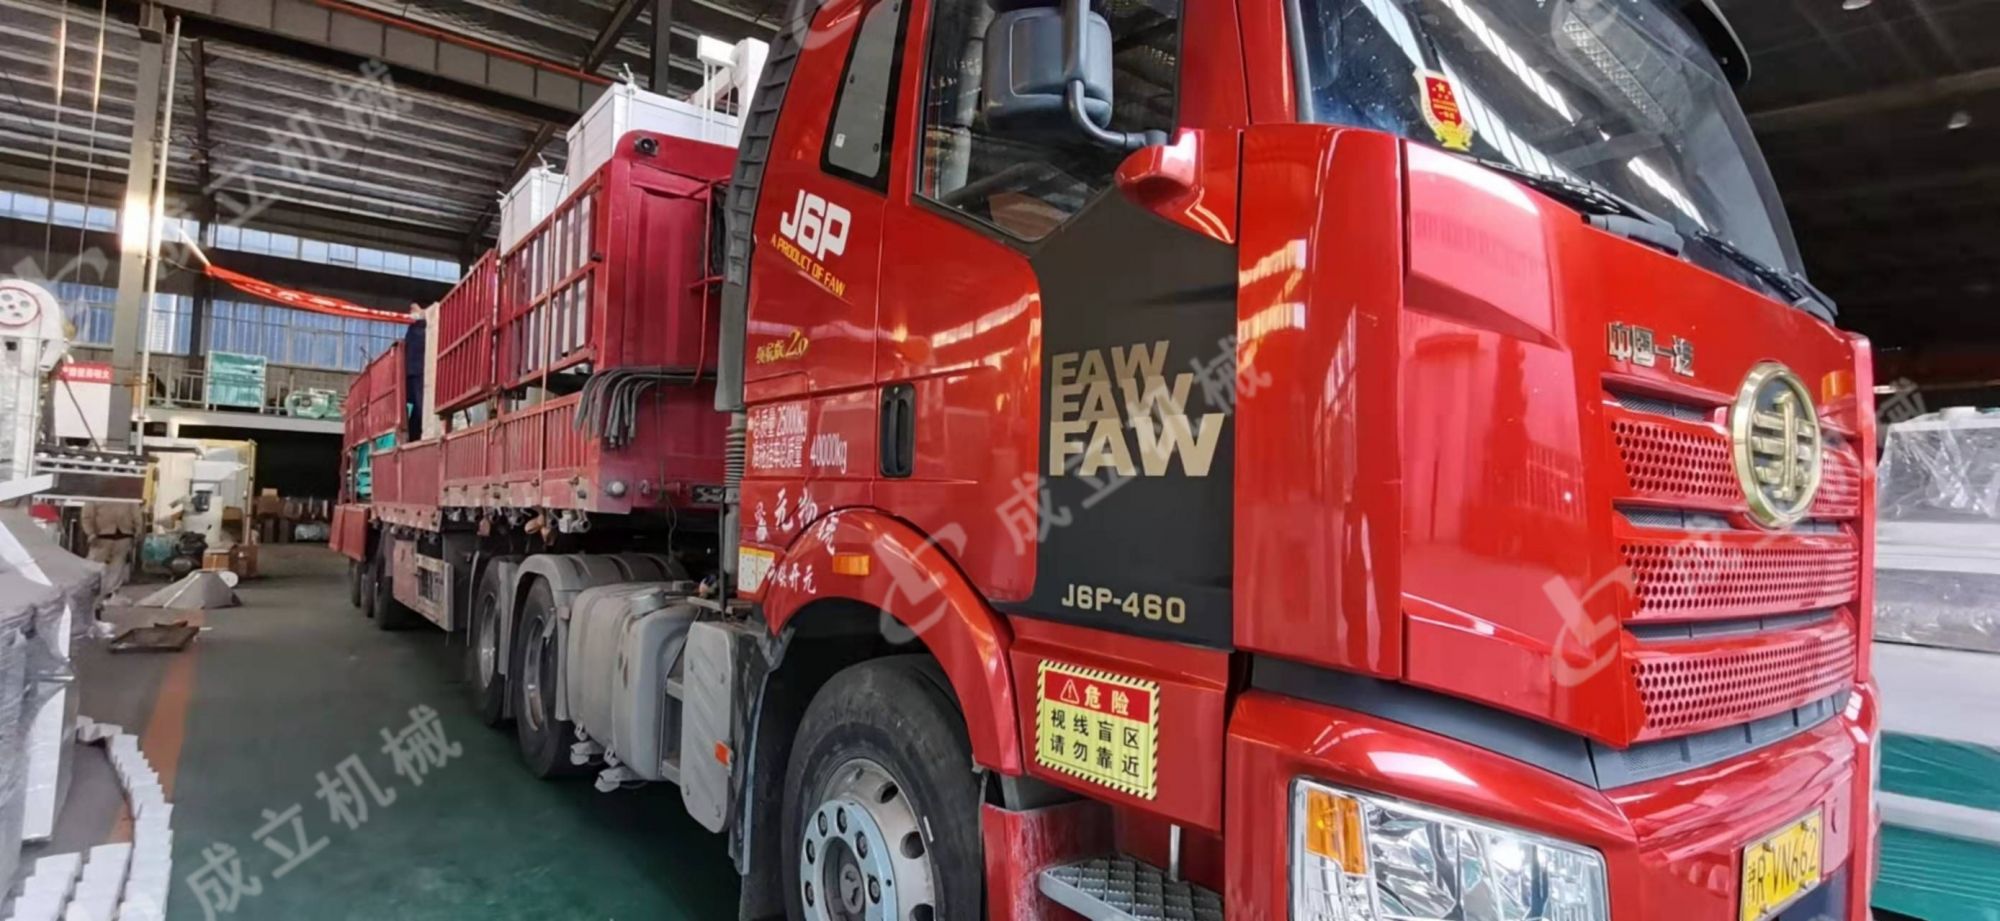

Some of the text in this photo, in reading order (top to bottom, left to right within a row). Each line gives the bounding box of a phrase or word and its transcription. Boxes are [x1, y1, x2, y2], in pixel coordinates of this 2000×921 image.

[780, 189, 851, 262] J6P
[770, 233, 846, 297] A PRODUCT OF FAW
[809, 432, 848, 475] 40000kg
[1049, 412, 1225, 477] FAW
[1061, 583, 1187, 624] J6P-460
[1084, 683, 1130, 716] 危险
[1050, 708, 1140, 750] 视线盲区
[1049, 733, 1140, 778] 请勿靠近
